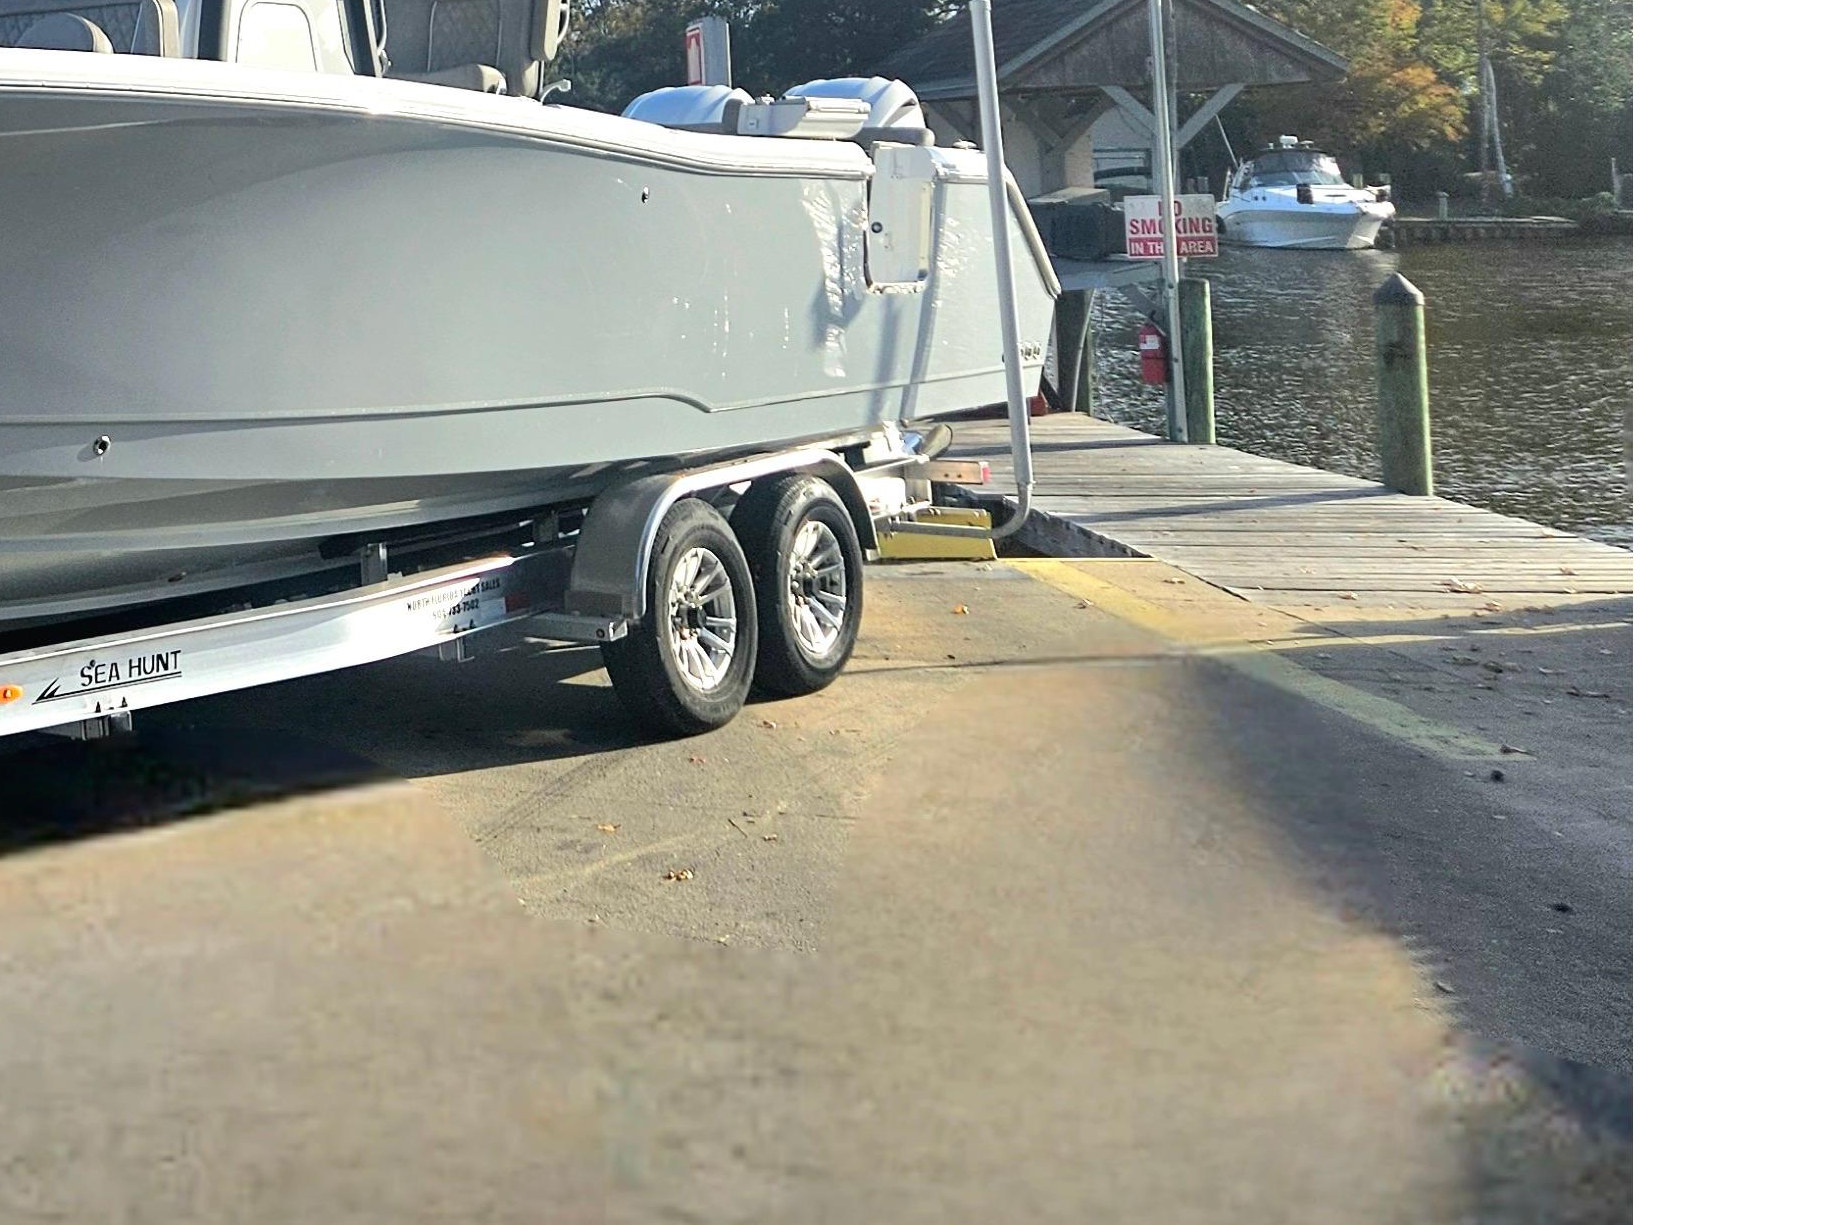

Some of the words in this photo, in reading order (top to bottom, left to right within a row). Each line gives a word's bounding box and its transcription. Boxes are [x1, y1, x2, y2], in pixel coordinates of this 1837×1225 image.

[1131, 241, 1144, 255] IN
[1147, 241, 1165, 254] TH
[1180, 240, 1214, 254] AREA
[80, 660, 120, 687] SEA
[128, 650, 182, 678] HUNT
